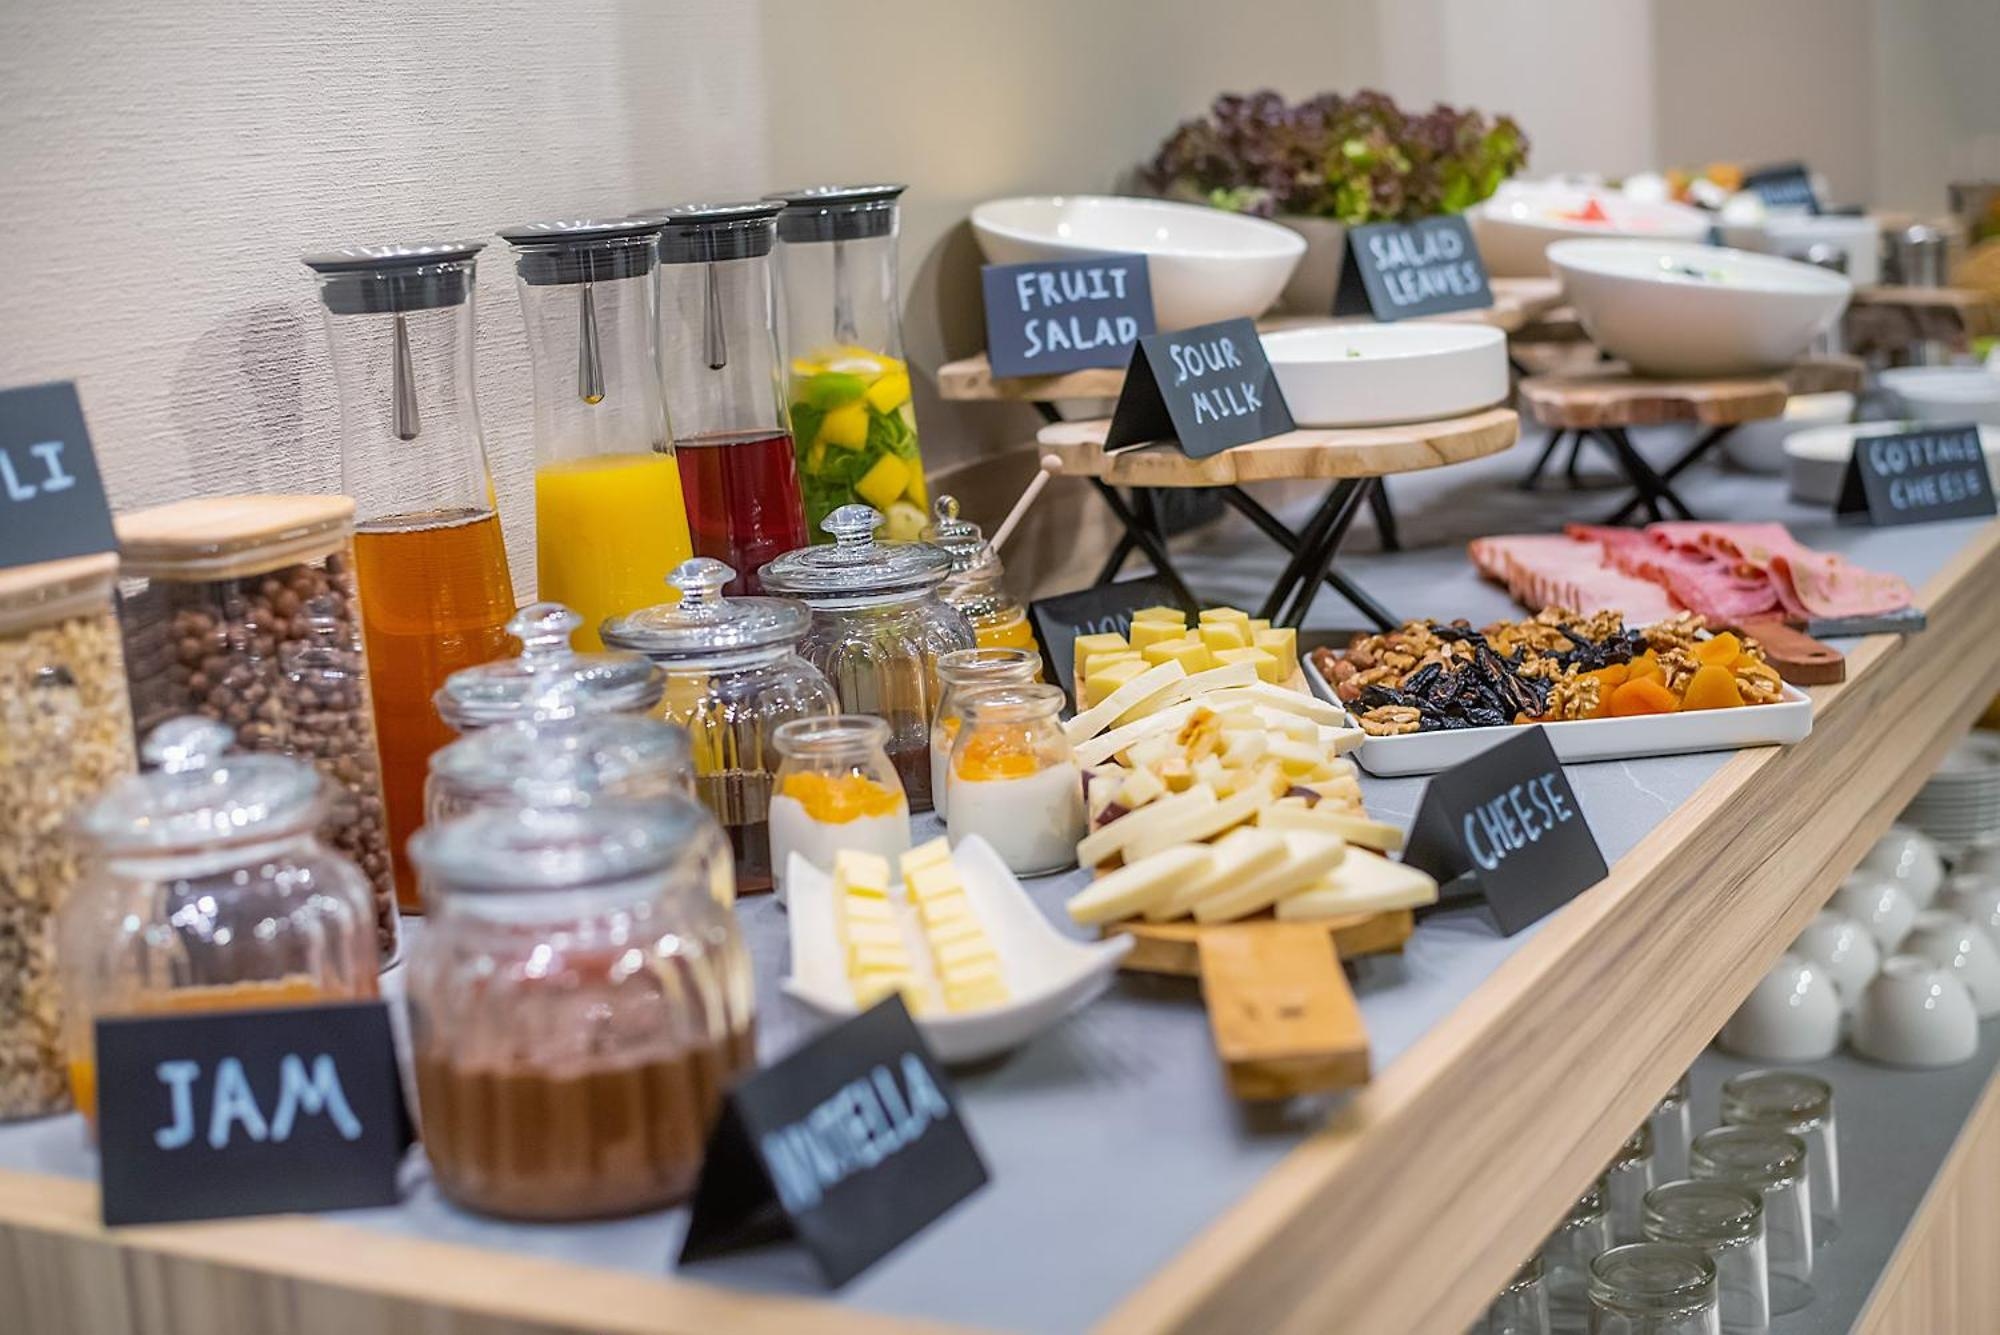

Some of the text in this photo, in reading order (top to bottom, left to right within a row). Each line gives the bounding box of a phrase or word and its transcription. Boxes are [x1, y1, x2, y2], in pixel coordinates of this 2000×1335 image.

[1369, 228, 1463, 271] SALAD
[1016, 268, 1128, 311] FRUIT
[1383, 260, 1481, 306] LEAVES
[1023, 316, 1138, 358] SALAD
[1169, 337, 1242, 386] SOUR
[1192, 381, 1262, 425] MILK
[1463, 773, 1574, 870] CHEESE
[154, 1053, 363, 1150] JAM
